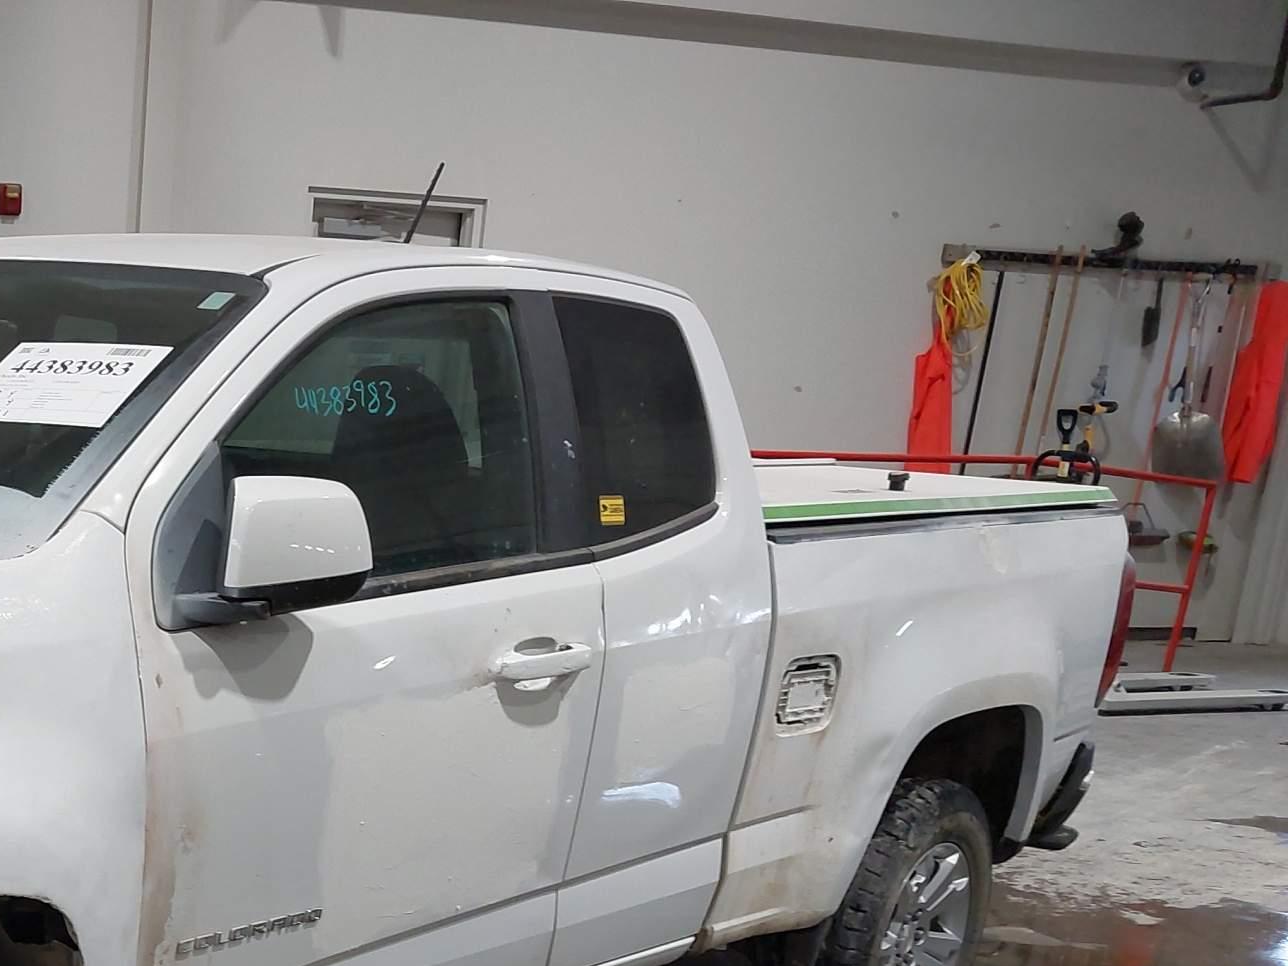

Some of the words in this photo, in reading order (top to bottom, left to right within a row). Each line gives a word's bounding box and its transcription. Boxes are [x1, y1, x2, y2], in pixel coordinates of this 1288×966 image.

[11, 359, 134, 376] 44383983
[294, 379, 397, 417] 44383983
[175, 908, 323, 953] COLORADO
